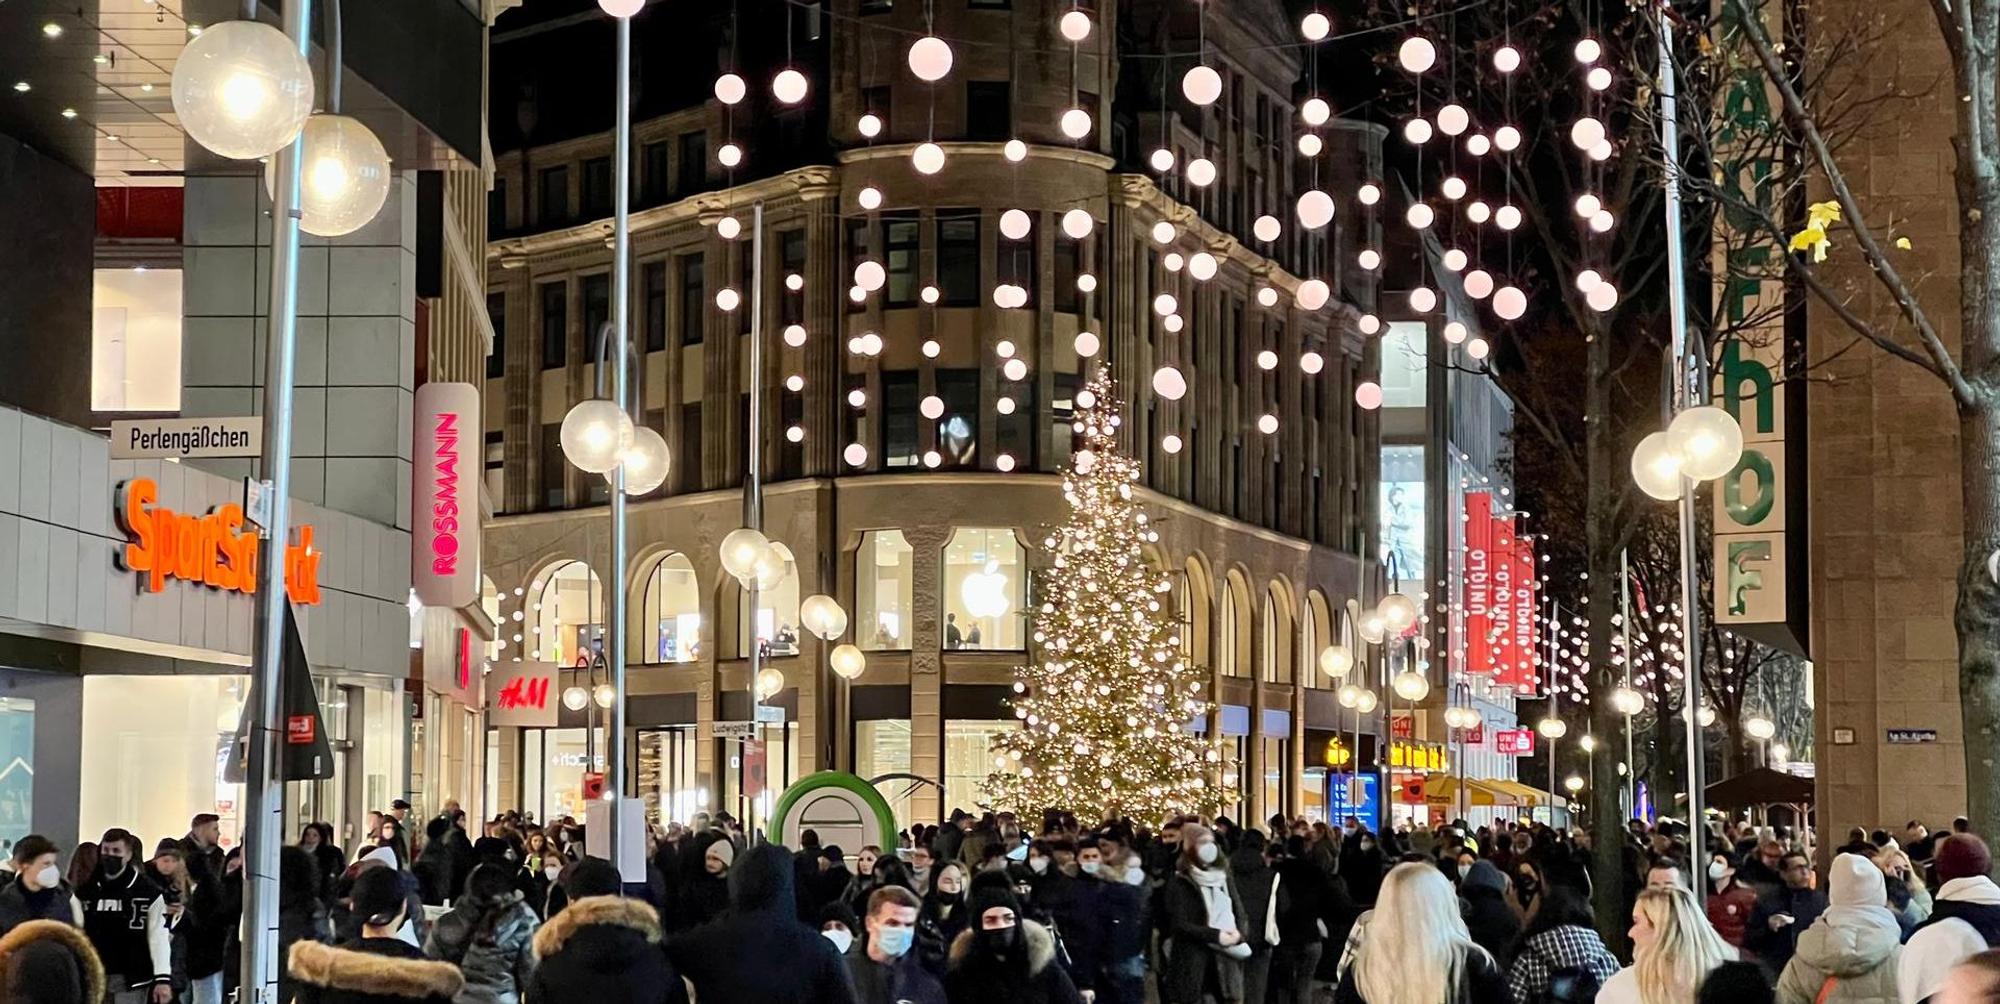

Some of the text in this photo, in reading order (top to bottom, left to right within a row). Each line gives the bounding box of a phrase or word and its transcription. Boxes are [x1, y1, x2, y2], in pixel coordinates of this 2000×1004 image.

[130, 425, 249, 455] Perlengäßchen
[432, 413, 459, 576] ROSSMANN
[124, 477, 322, 606] SportScck
[1470, 549, 1488, 615] UNIQLO
[497, 676, 549, 710] H&M
